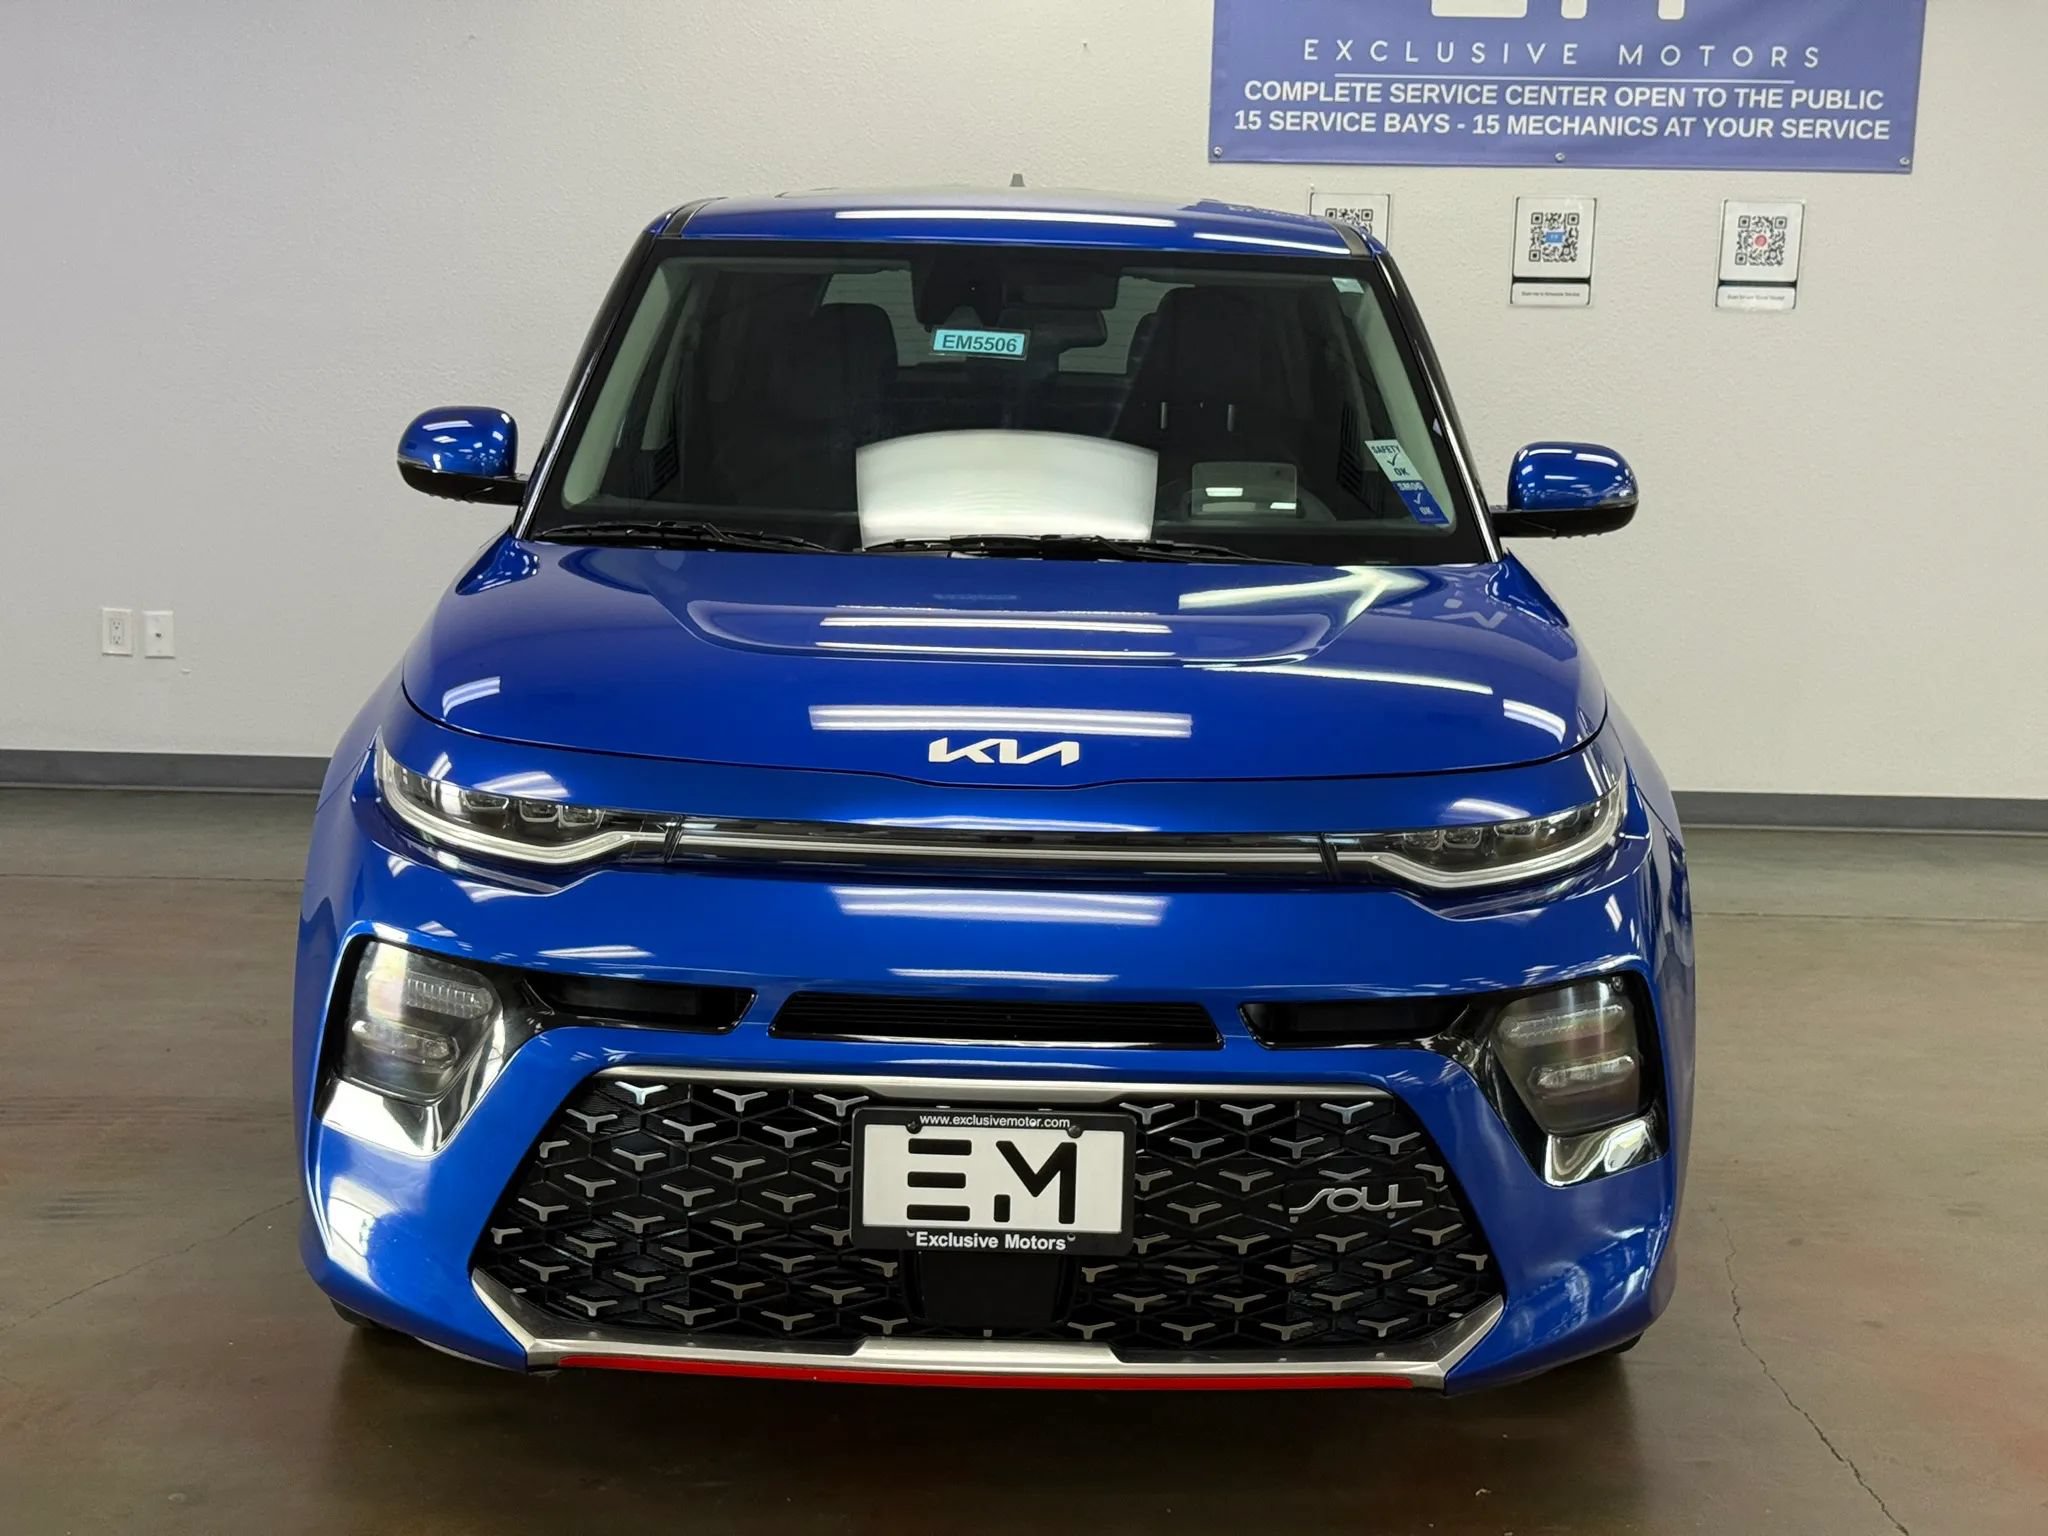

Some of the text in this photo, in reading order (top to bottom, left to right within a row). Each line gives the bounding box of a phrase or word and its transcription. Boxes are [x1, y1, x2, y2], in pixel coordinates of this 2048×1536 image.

[1303, 39, 1819, 68] EXCLUSIVE MOTORS
[1243, 80, 1885, 111] COMPLETE SERVICE CENTER OPEN TO THE PUBLIC
[1234, 110, 1263, 131] 15
[1268, 110, 1377, 133] SERVICE
[1383, 112, 1451, 134] BAYS
[1472, 114, 1501, 135] 15
[1507, 114, 1658, 137] MECHANICS
[1663, 117, 1697, 137] AT
[1702, 117, 1774, 139] YOUR
[1780, 118, 1891, 140] SERVICE
[942, 334, 1018, 353] EM5506
[1370, 444, 1401, 455] SAFETY
[1394, 467, 1410, 477] OK
[928, 737, 1080, 767] KIA
[919, 1114, 1071, 1128] www.exclusivemotor.com
[915, 1231, 1067, 1251] Exclusive Motors
